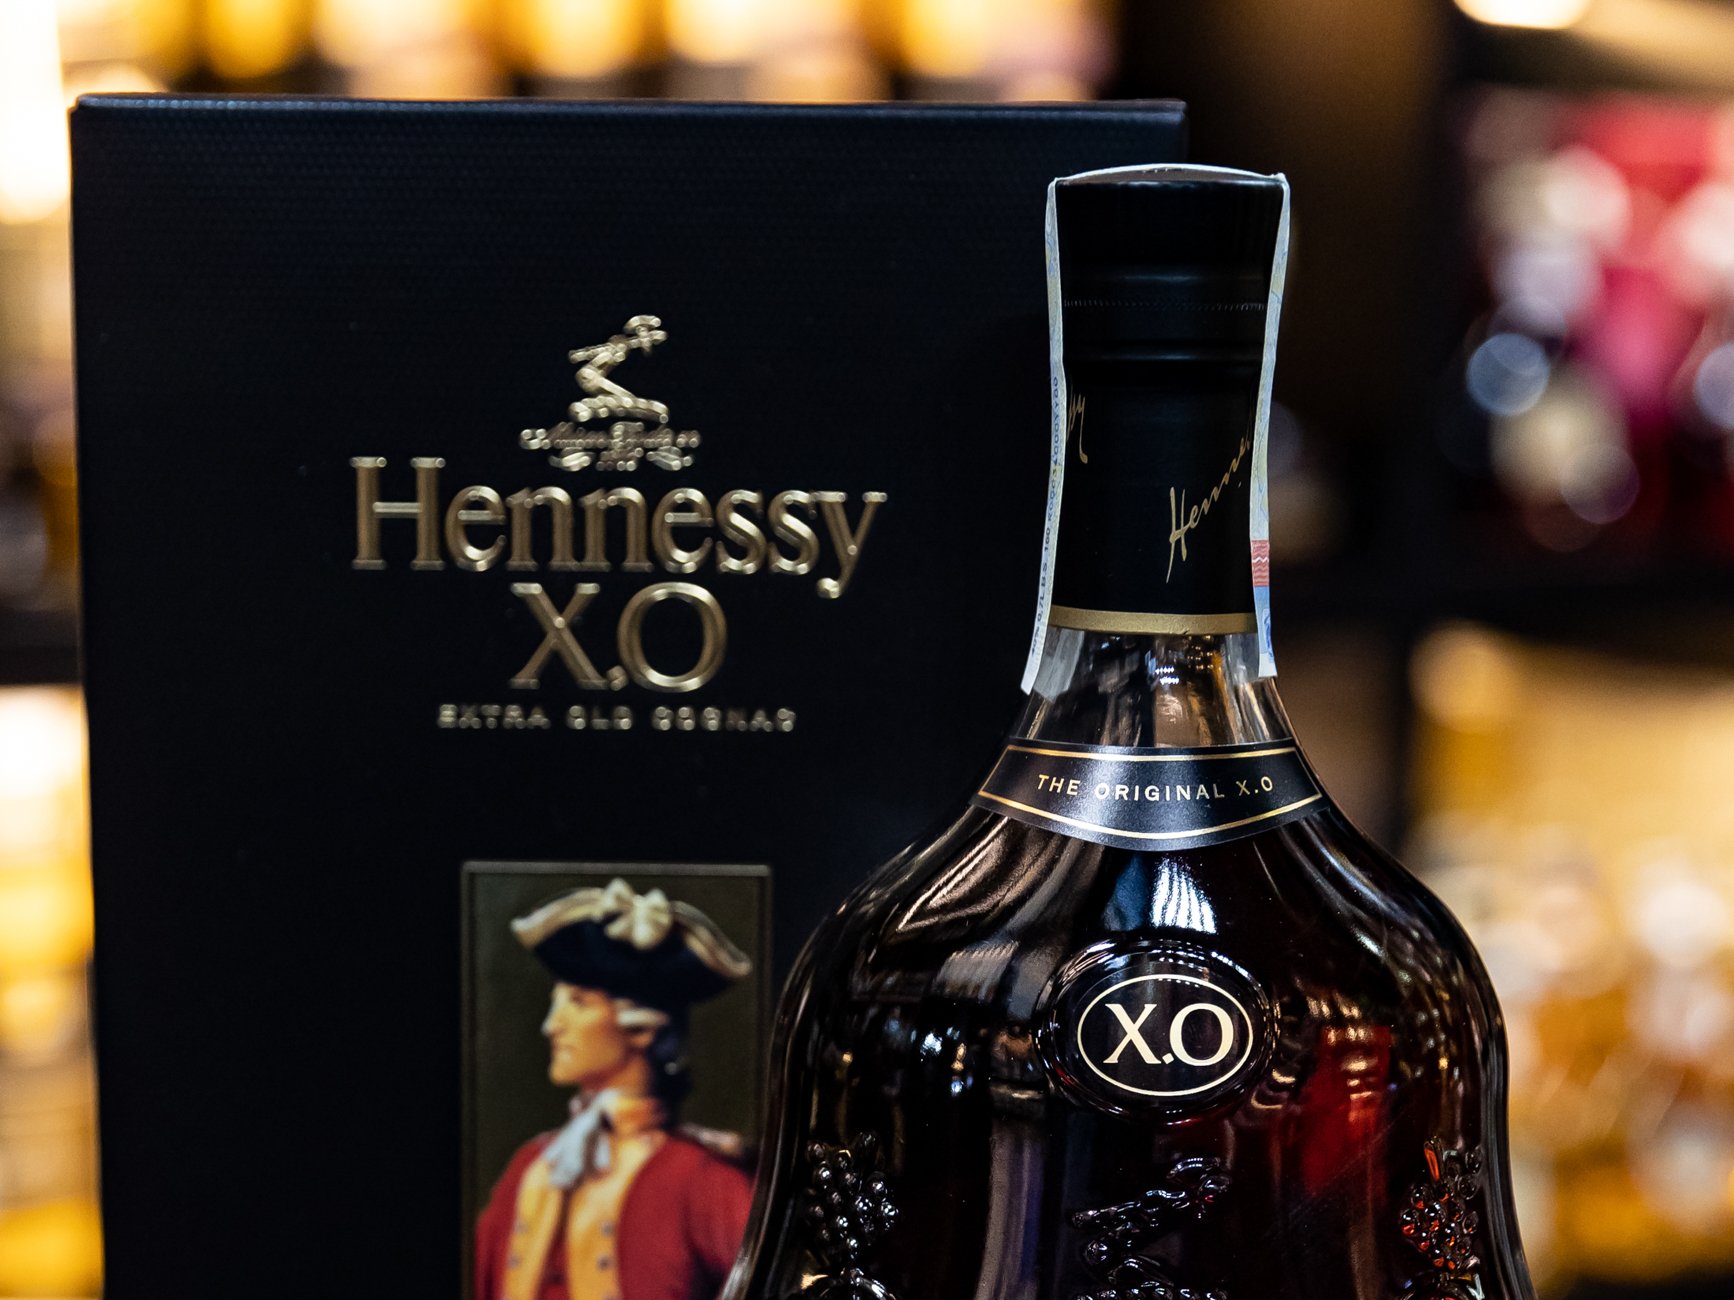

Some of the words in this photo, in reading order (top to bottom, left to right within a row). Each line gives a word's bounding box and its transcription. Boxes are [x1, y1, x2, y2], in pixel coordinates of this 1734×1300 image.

[351, 457, 888, 599] Hennessy
[510, 582, 727, 693] X.O
[1037, 774, 1081, 796] THE
[1094, 781, 1226, 802] ORIGINAL
[1236, 775, 1275, 796] X.O
[1103, 1002, 1235, 1067] X.O
